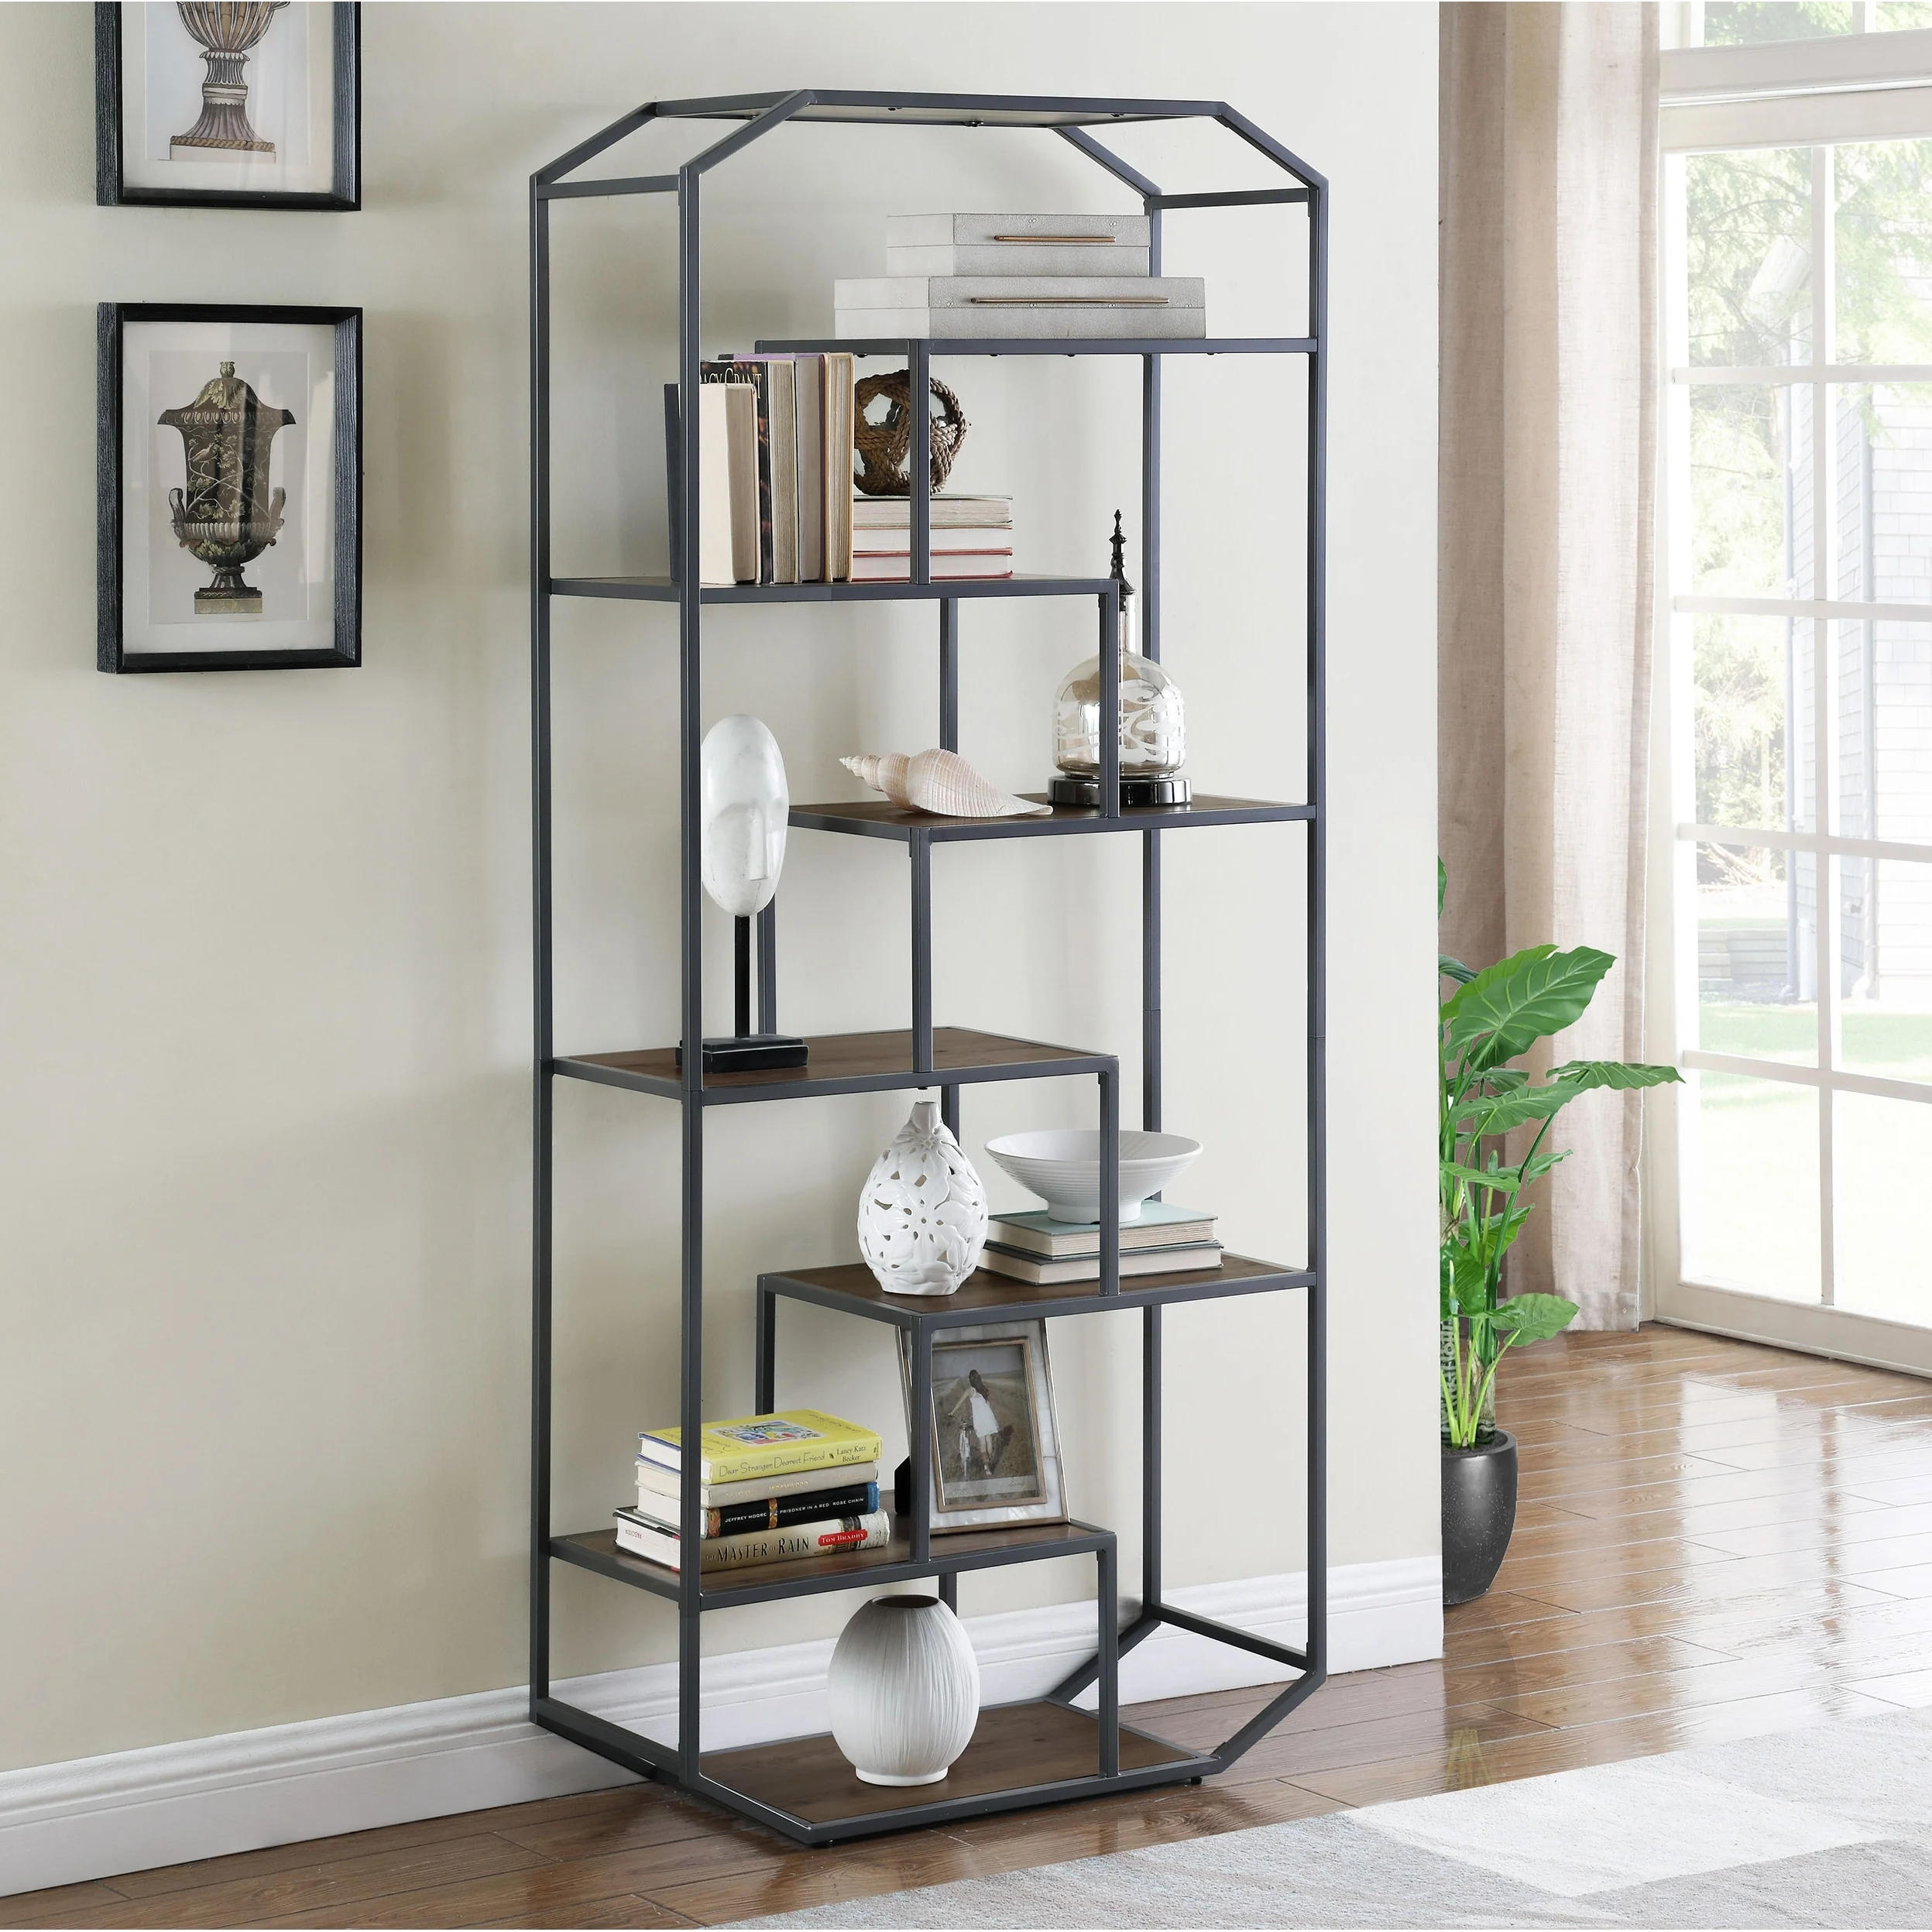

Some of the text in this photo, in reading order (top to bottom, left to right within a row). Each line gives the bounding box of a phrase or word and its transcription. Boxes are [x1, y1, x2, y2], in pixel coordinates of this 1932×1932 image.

[719, 1466, 738, 1477] Dear
[774, 1457, 801, 1468] Dearest
[804, 1450, 825, 1464] Friend
[718, 1543, 767, 1562] MASTER
[778, 1537, 809, 1554] RAIN
